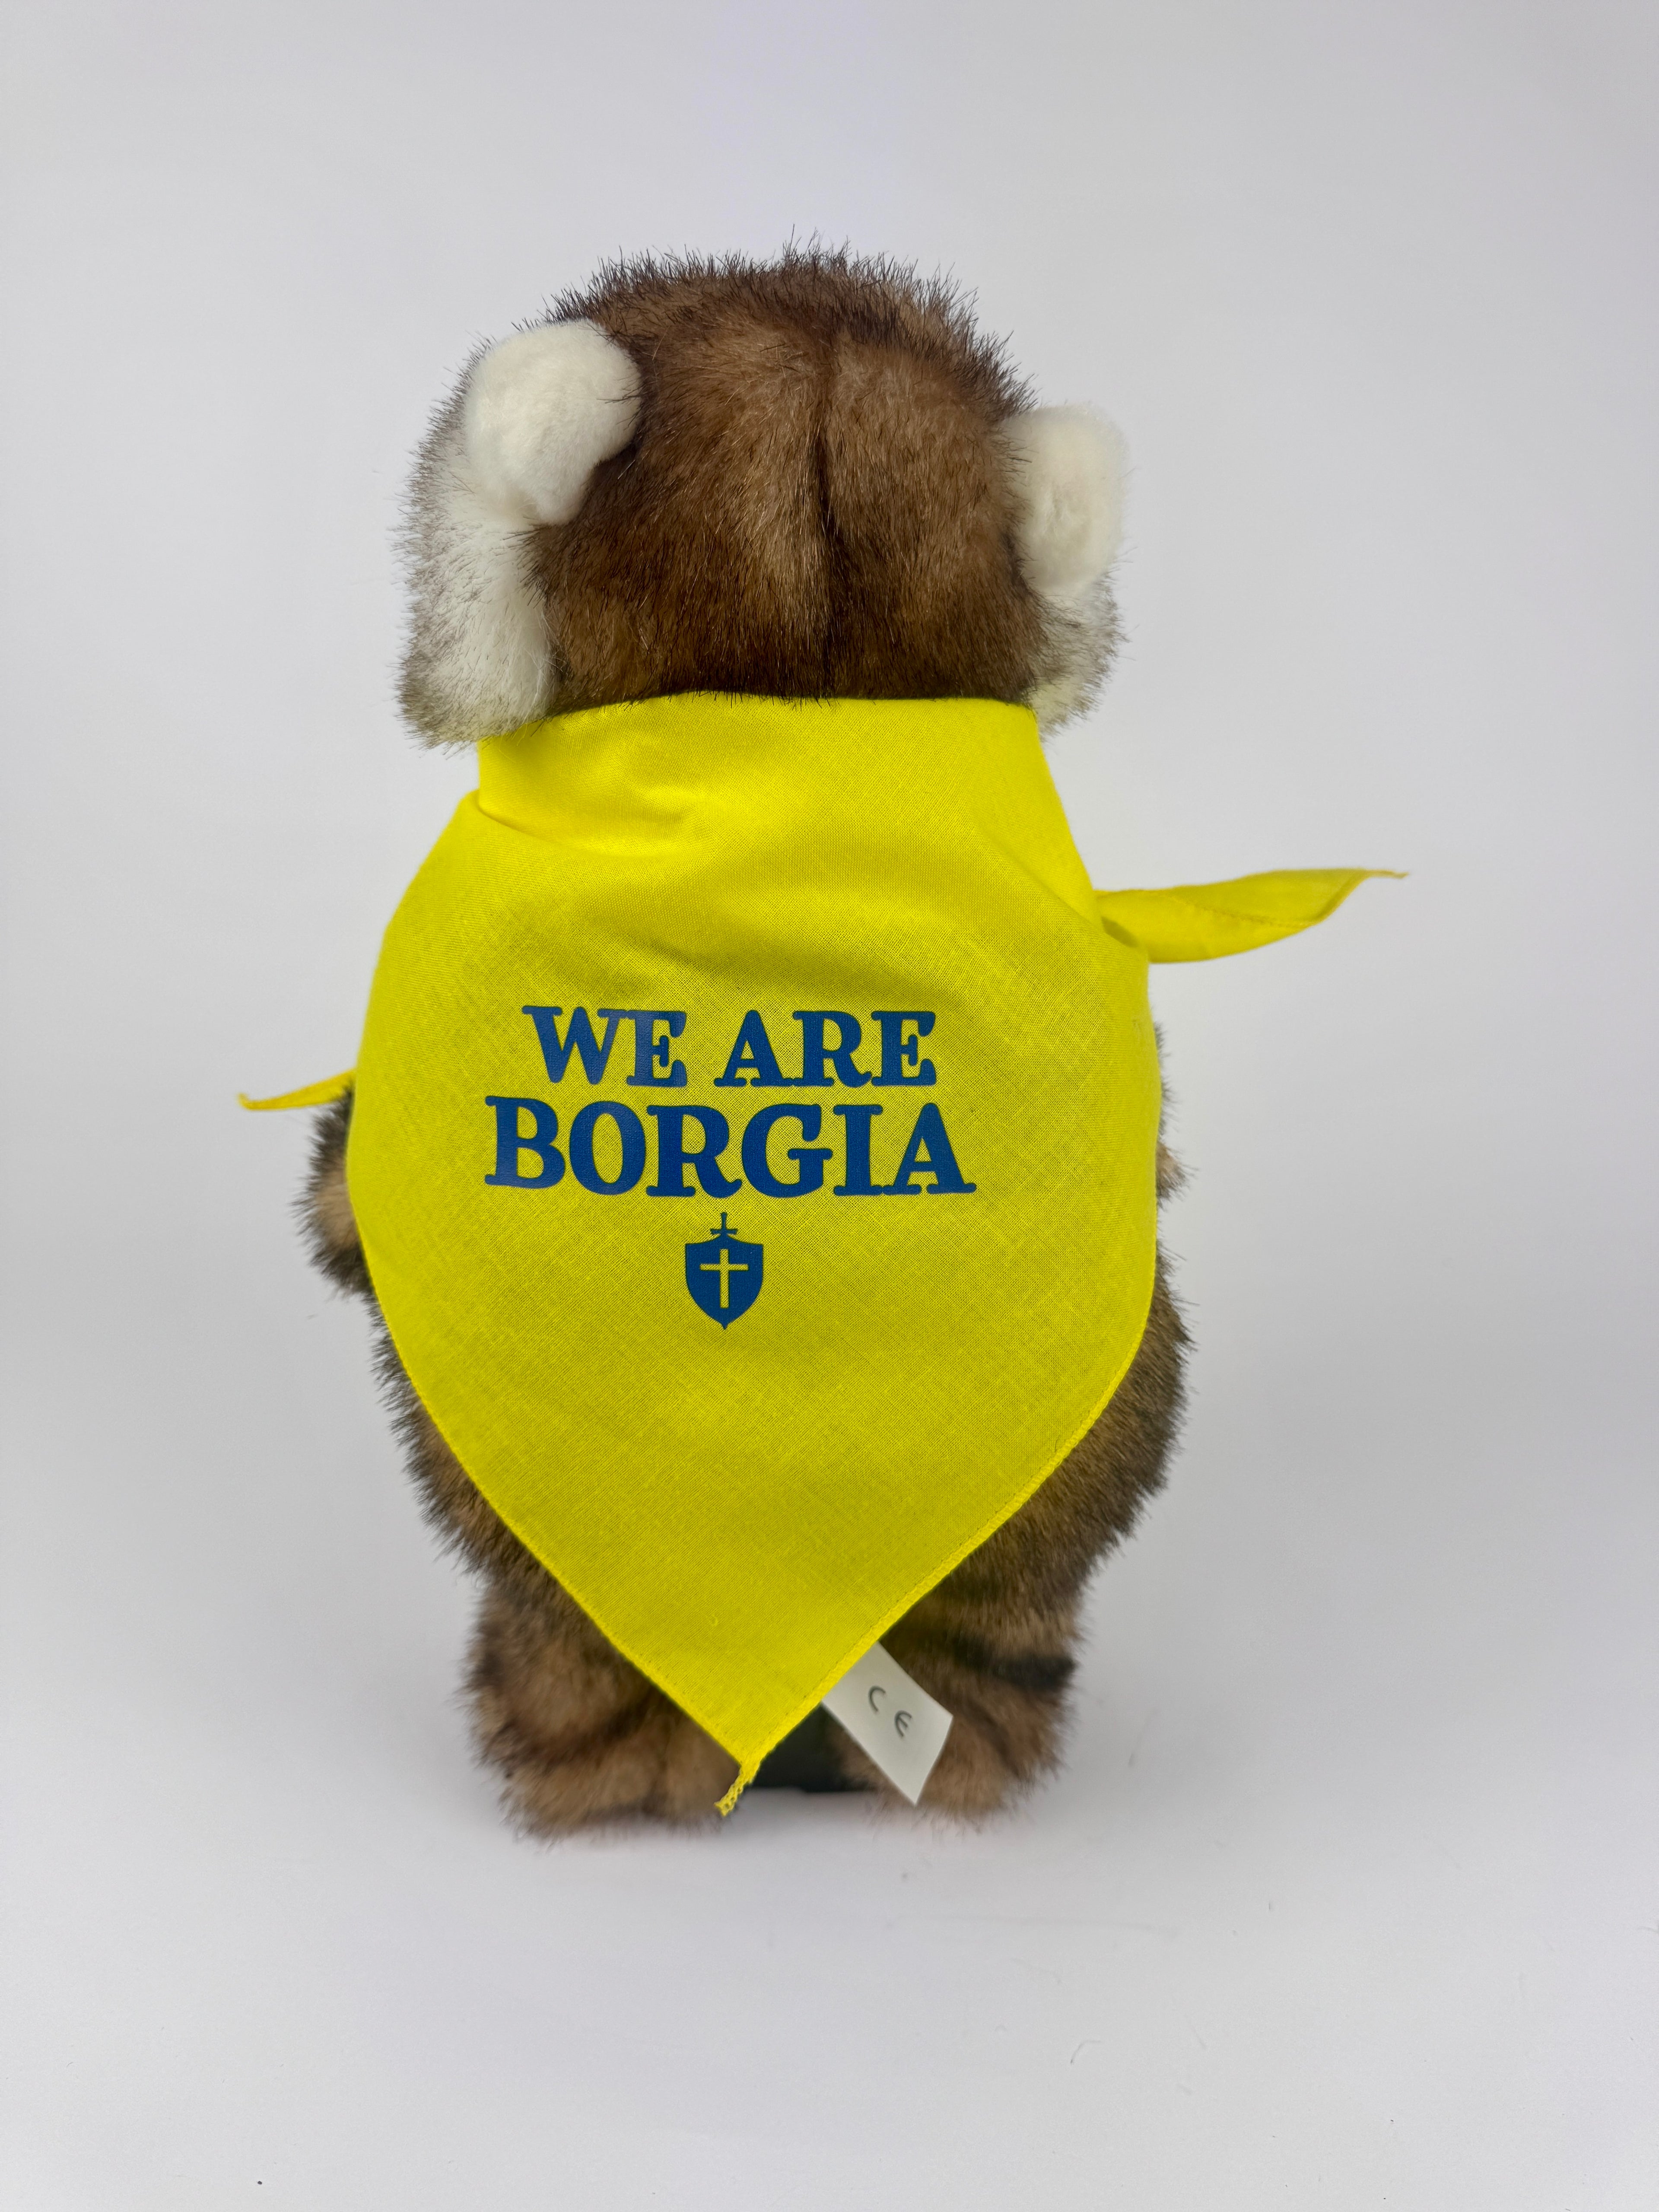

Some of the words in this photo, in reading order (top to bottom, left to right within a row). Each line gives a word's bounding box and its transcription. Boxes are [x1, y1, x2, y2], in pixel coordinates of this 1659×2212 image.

[522, 1005, 687, 1087] WE
[714, 1010, 937, 1087] ARE
[485, 1095, 977, 1198] BORGIA
[868, 1685, 912, 1738] CE
